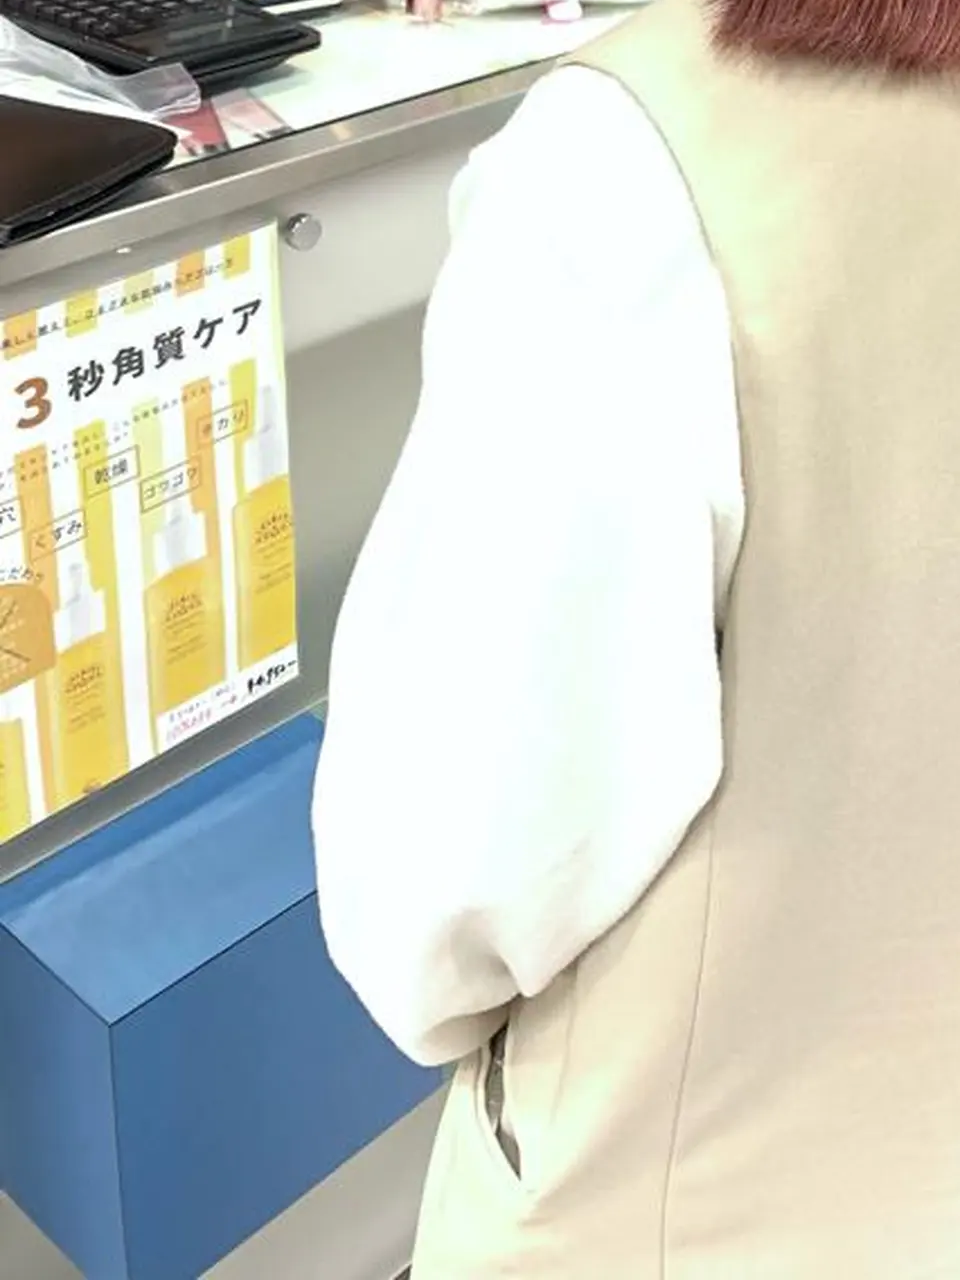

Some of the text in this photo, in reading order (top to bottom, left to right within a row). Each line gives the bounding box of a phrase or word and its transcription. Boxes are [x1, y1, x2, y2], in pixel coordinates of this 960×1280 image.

[94, 458, 128, 485] 乾燥
[35, 519, 83, 549] くすみ
